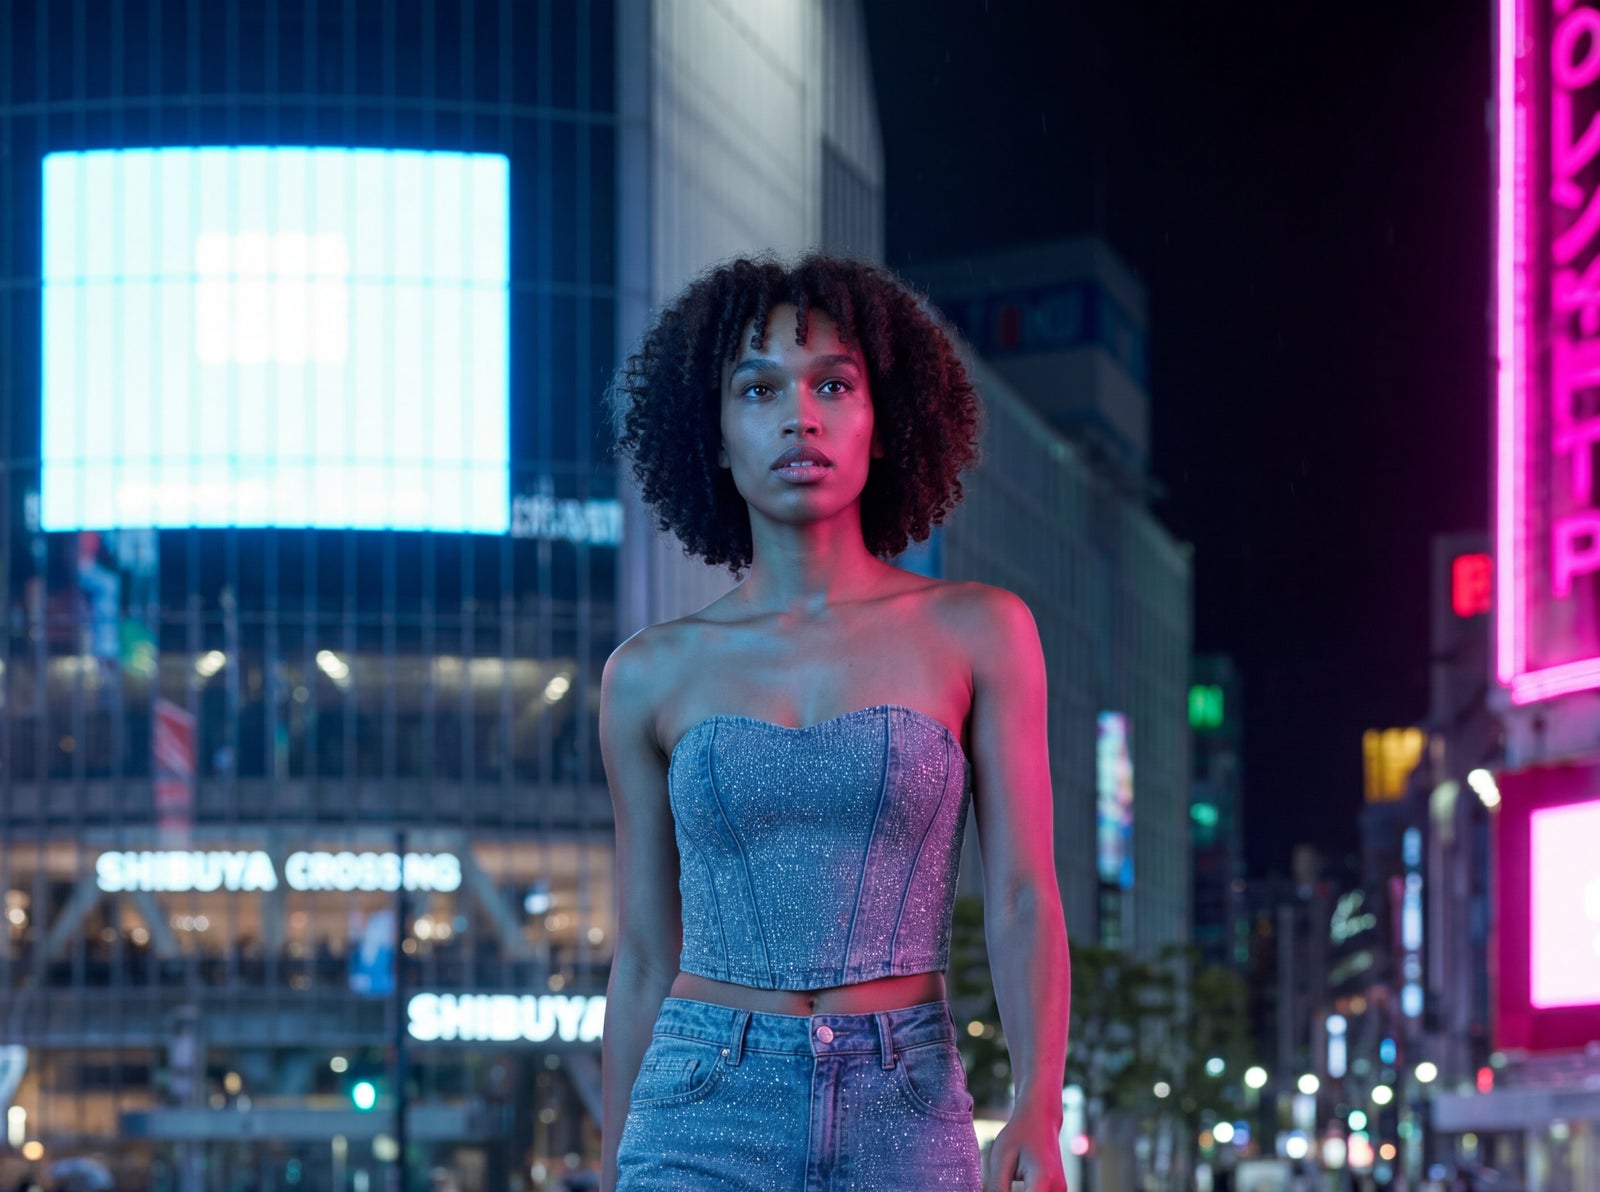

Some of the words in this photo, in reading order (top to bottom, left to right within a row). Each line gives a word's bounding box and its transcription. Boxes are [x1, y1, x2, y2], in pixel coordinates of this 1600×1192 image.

[96, 851, 278, 892] SHIBUYA
[285, 851, 462, 892] CROSSNG
[407, 992, 606, 1042] SHIBUYA
